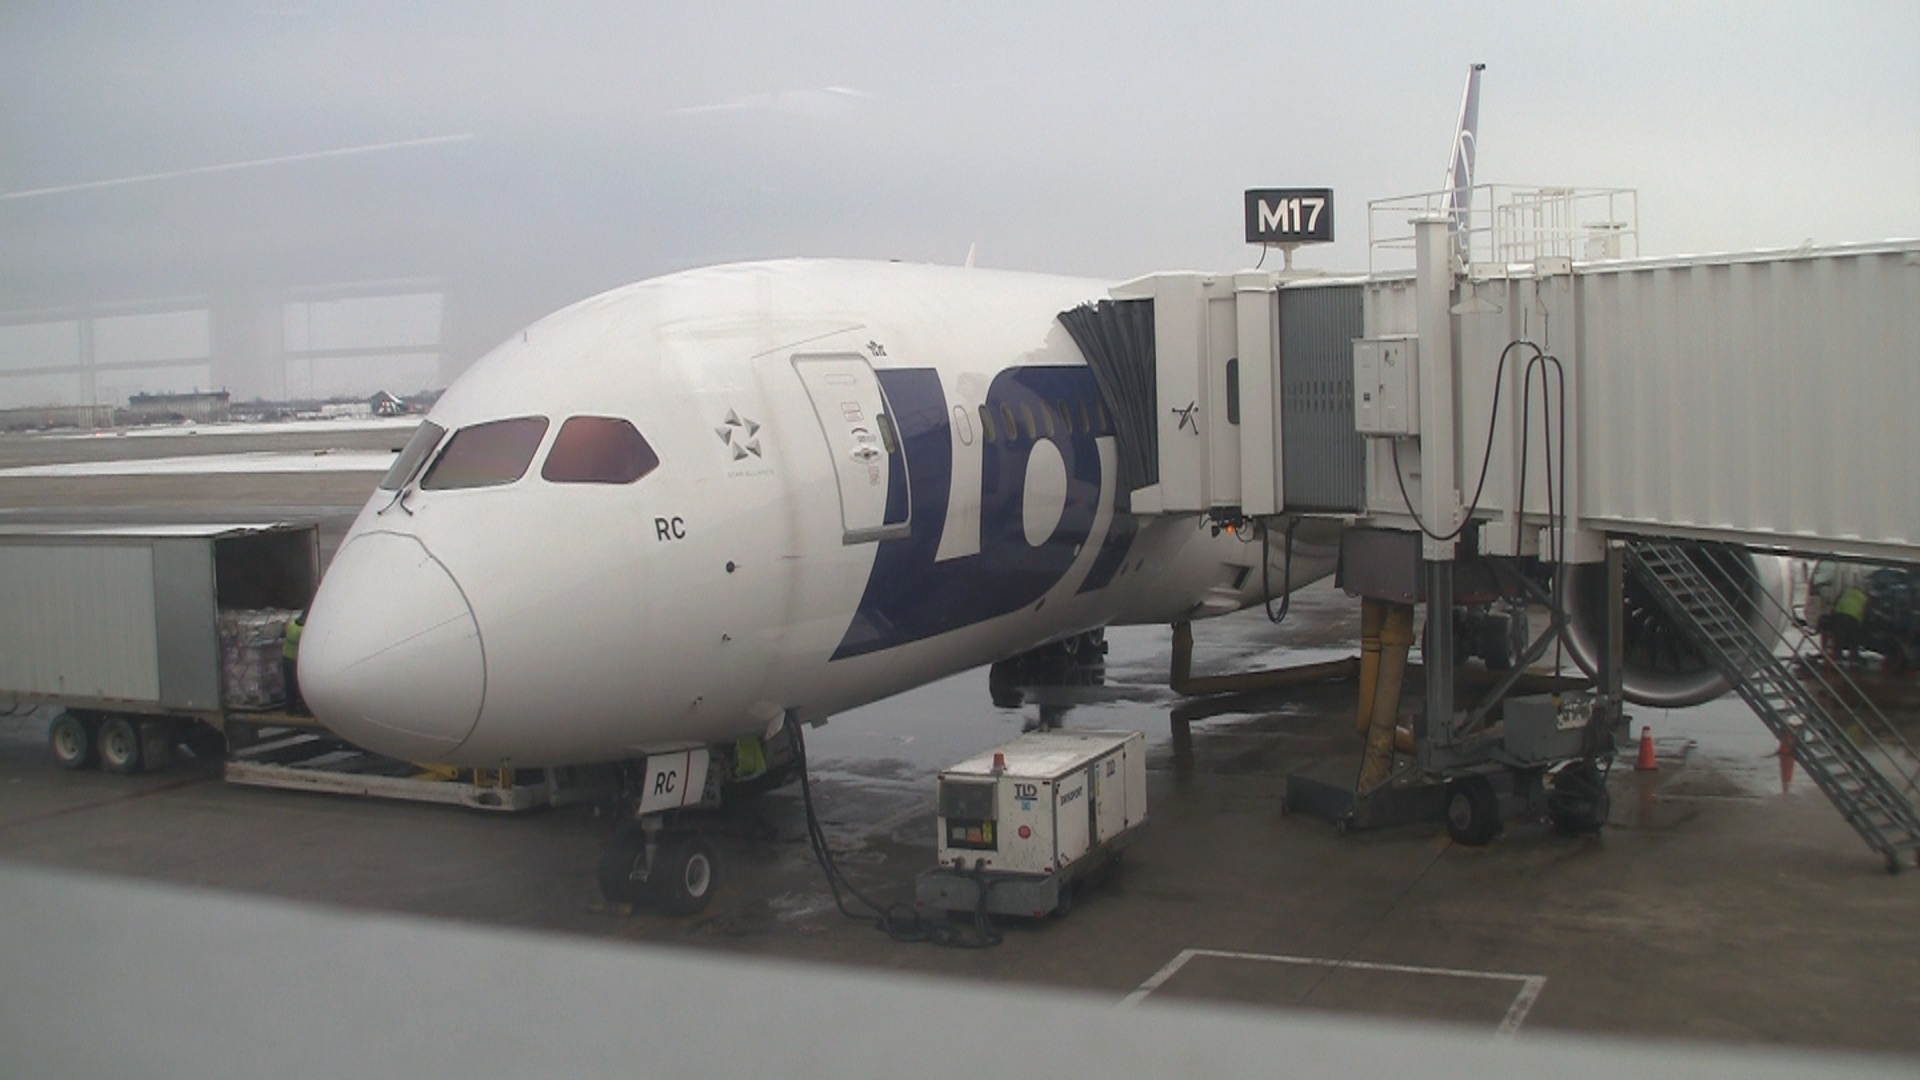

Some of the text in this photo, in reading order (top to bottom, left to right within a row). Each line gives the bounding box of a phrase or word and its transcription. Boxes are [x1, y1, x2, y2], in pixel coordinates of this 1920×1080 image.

[1258, 197, 1325, 232] M17
[654, 517, 686, 541] RC
[654, 771, 677, 796] RC
[1014, 783, 1037, 799] TLD
